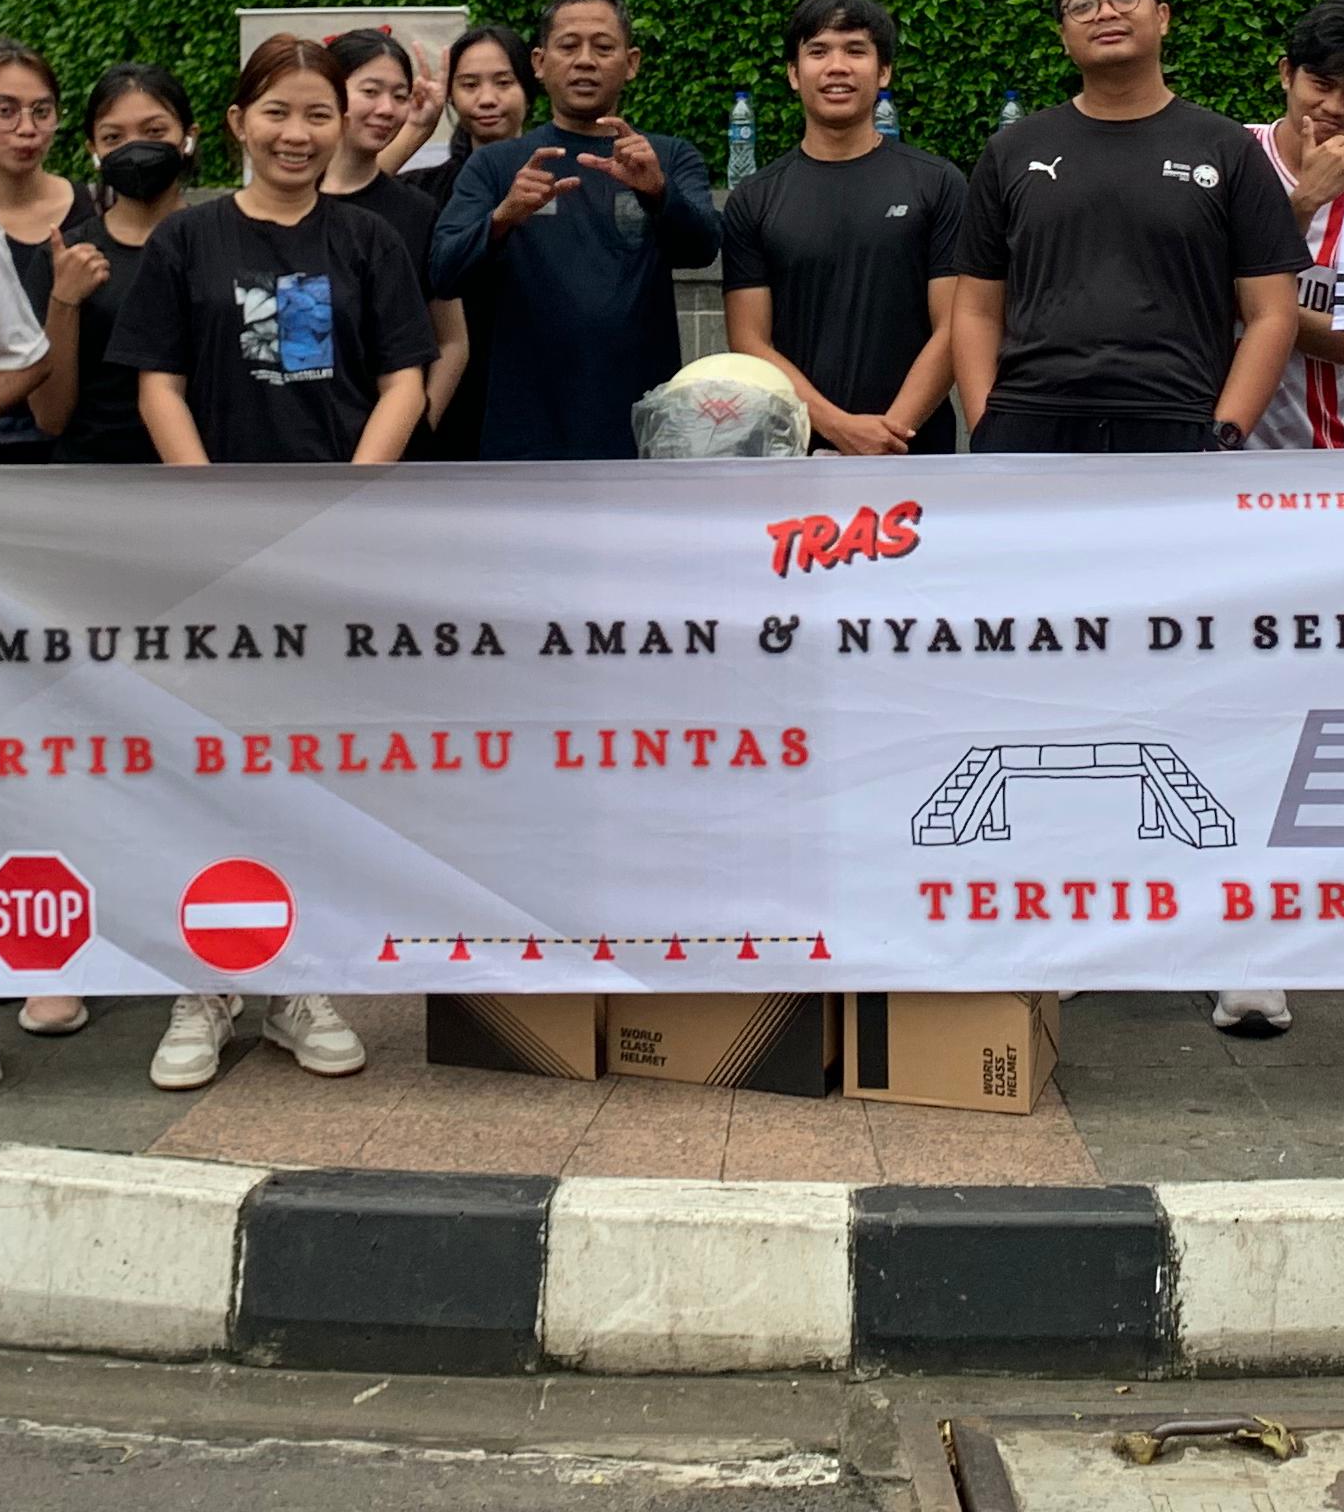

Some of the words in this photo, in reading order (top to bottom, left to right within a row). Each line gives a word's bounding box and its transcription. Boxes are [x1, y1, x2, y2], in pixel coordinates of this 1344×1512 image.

[765, 500, 923, 579] TRAS
[345, 621, 506, 658] RASA
[539, 619, 718, 656] AMAN
[758, 615, 800, 654] &
[837, 616, 1110, 654] NYAMAN
[1147, 615, 1216, 651] DI
[194, 729, 514, 776] BERLALU
[553, 726, 811, 770] LINTAS
[917, 879, 1180, 922] TERTIB
[620, 1026, 663, 1043] WORLD
[620, 1039, 656, 1054] CLASS
[620, 1051, 668, 1067] HELMET
[982, 1047, 994, 1096] WORLD
[995, 1055, 1006, 1097] CLASS
[1006, 1042, 1018, 1098] HELMET
